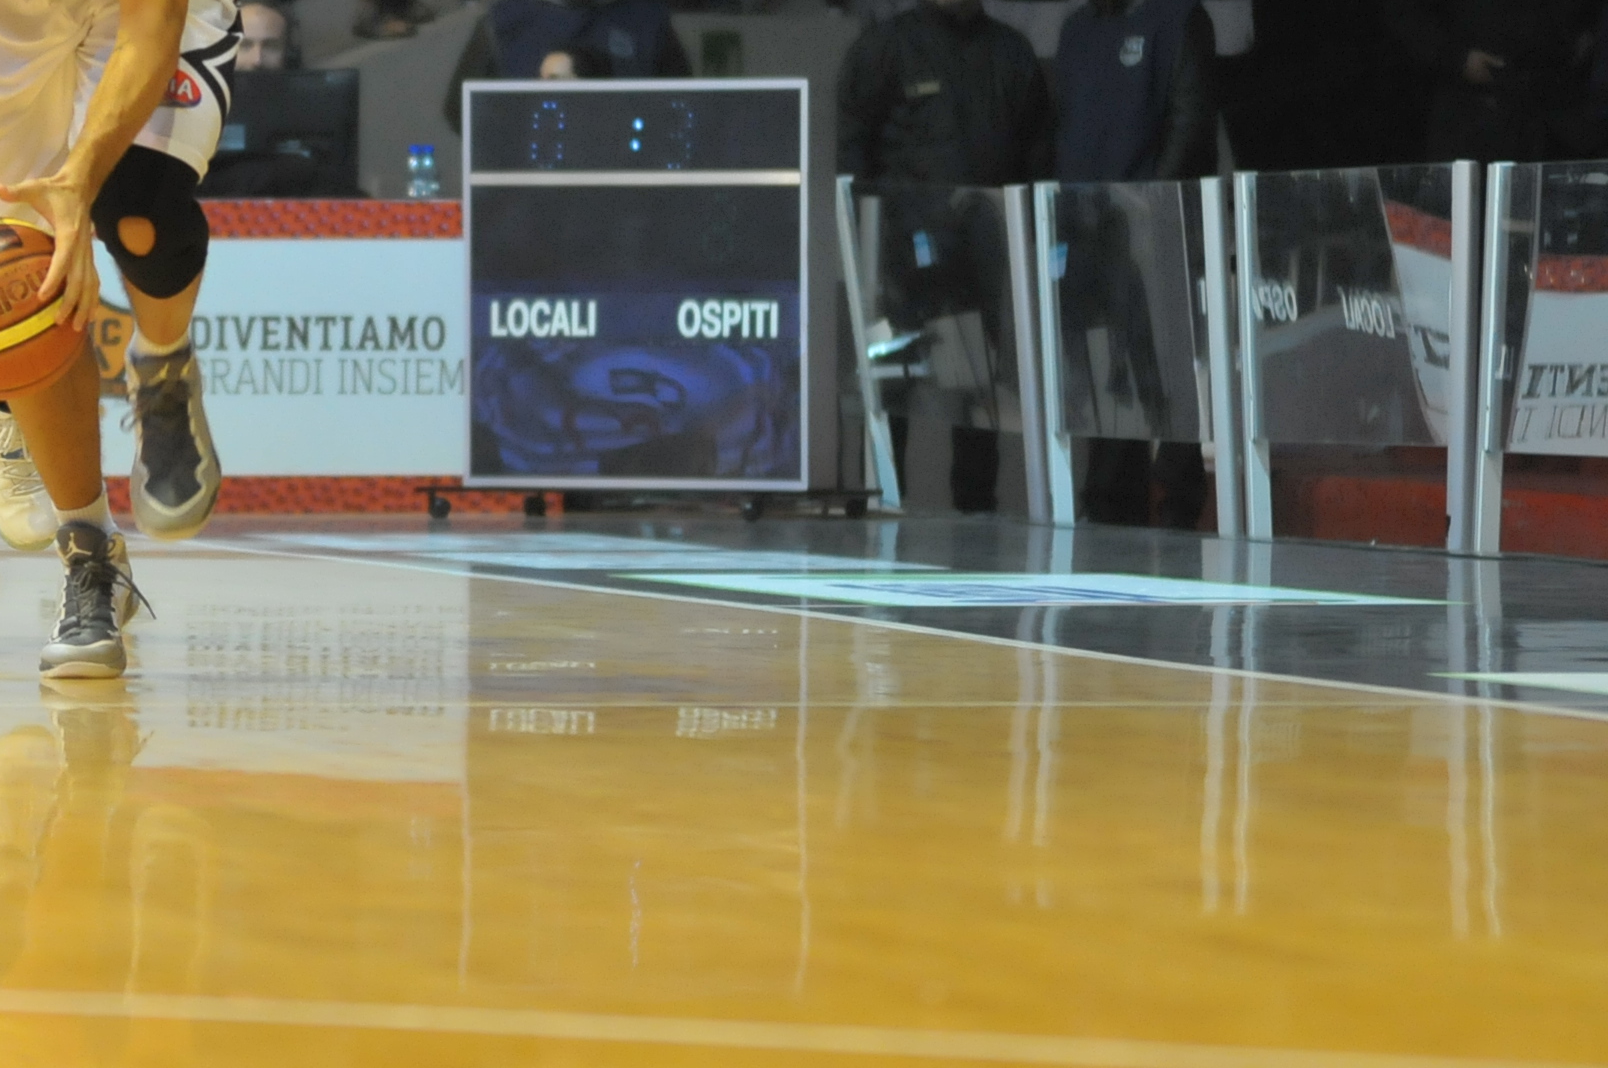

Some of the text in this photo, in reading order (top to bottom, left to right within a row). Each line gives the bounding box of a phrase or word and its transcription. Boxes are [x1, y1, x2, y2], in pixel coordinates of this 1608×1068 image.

[193, 315, 447, 352] DIVENTIAMO
[490, 299, 779, 339] LOCALI OSPITI
[200, 357, 323, 396] RANDI
